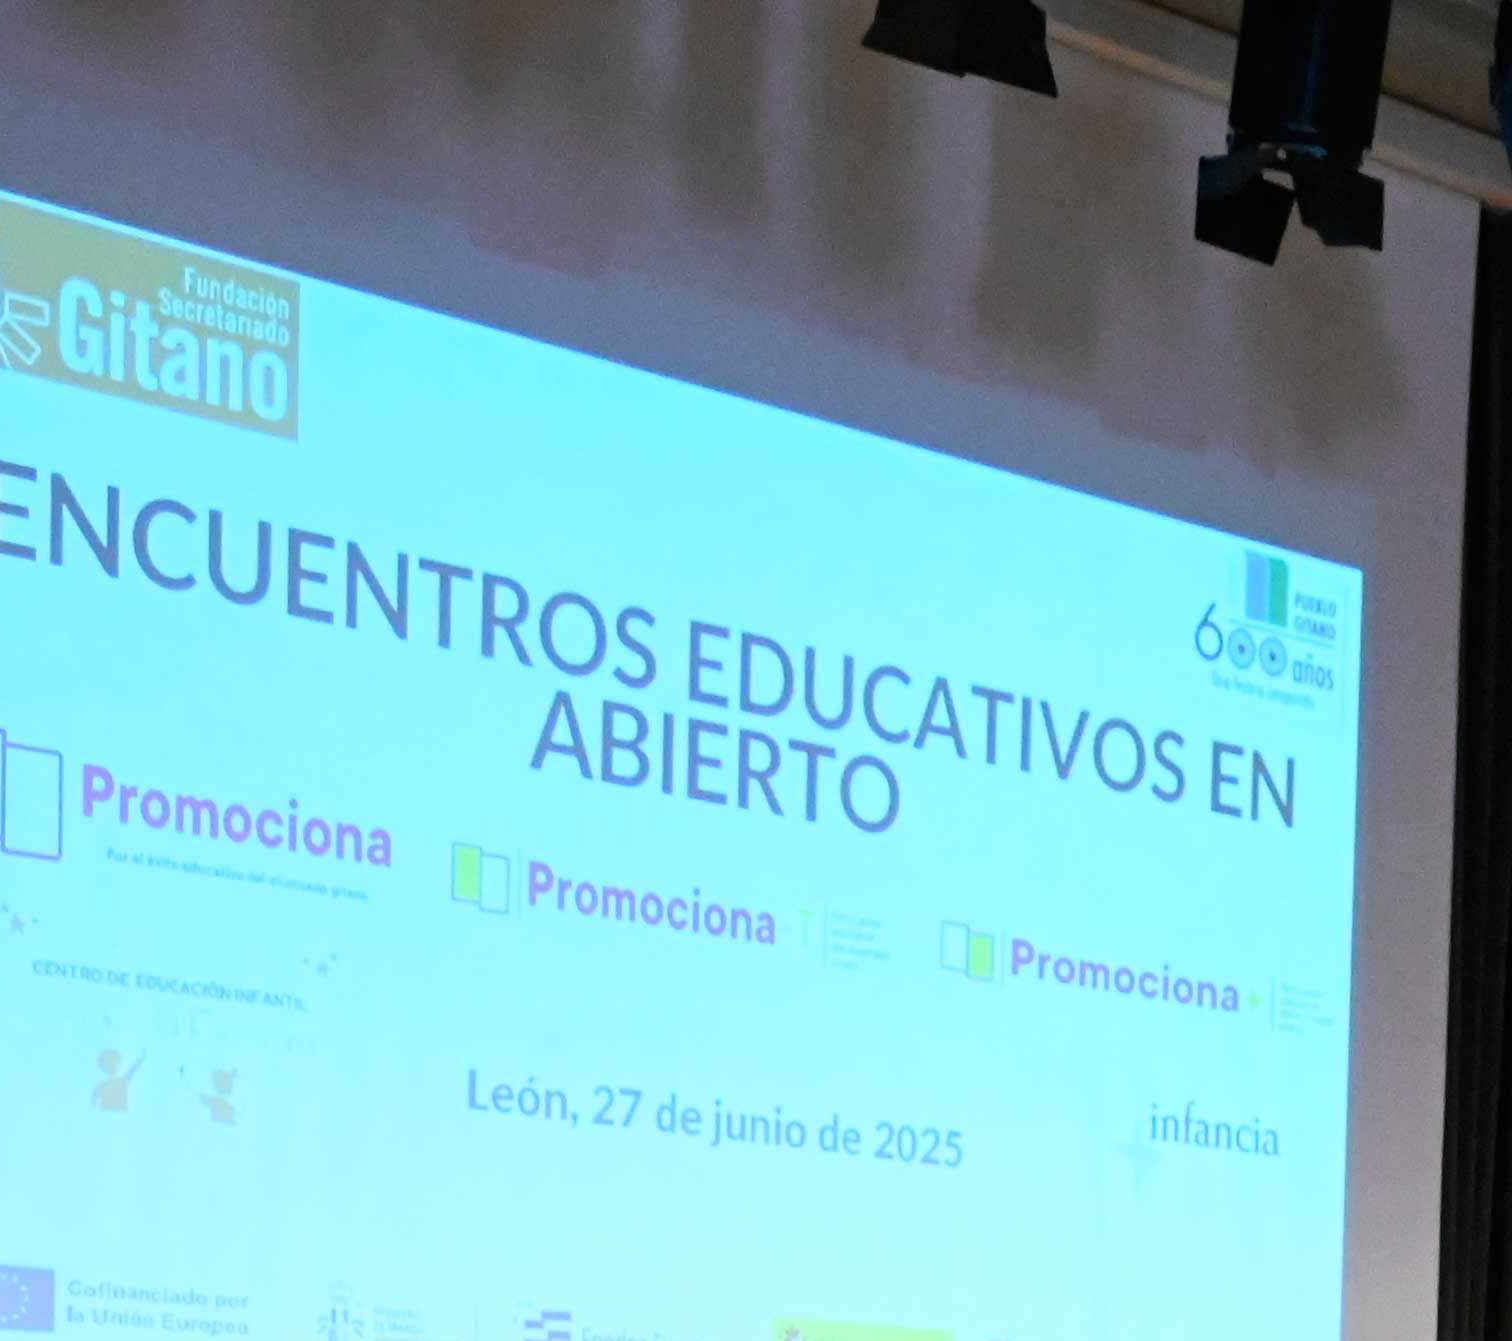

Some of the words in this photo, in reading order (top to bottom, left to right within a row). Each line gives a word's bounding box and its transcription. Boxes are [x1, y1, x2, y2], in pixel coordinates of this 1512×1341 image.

[159, 287, 289, 346] Secretariado
[184, 267, 289, 320] Fundación
[58, 276, 288, 422] Gitano
[1293, 652, 1334, 690] años
[689, 620, 1185, 802] EDUCATIVOS
[1210, 741, 1294, 828] EN
[530, 690, 899, 833] ABIERTO
[83, 764, 391, 867] Promociona
[529, 861, 776, 945] Promociona
[32, 960, 102, 983] CENTRO
[107, 970, 130, 988] DE
[135, 974, 233, 1002] EDUCACIÓN
[1011, 938, 1240, 1012] Promociona
[467, 1068, 578, 1127] León,
[591, 1085, 643, 1128] 27
[656, 1093, 702, 1136] de
[710, 1099, 807, 1148] junio
[818, 1113, 862, 1156] de
[873, 1121, 964, 1168] 2025
[1149, 1100, 1280, 1157] infancia
[67, 1279, 208, 1307] Cofinanciado
[214, 1294, 250, 1310] por
[91, 1308, 156, 1328] Unión
[161, 1312, 250, 1337] Europea
